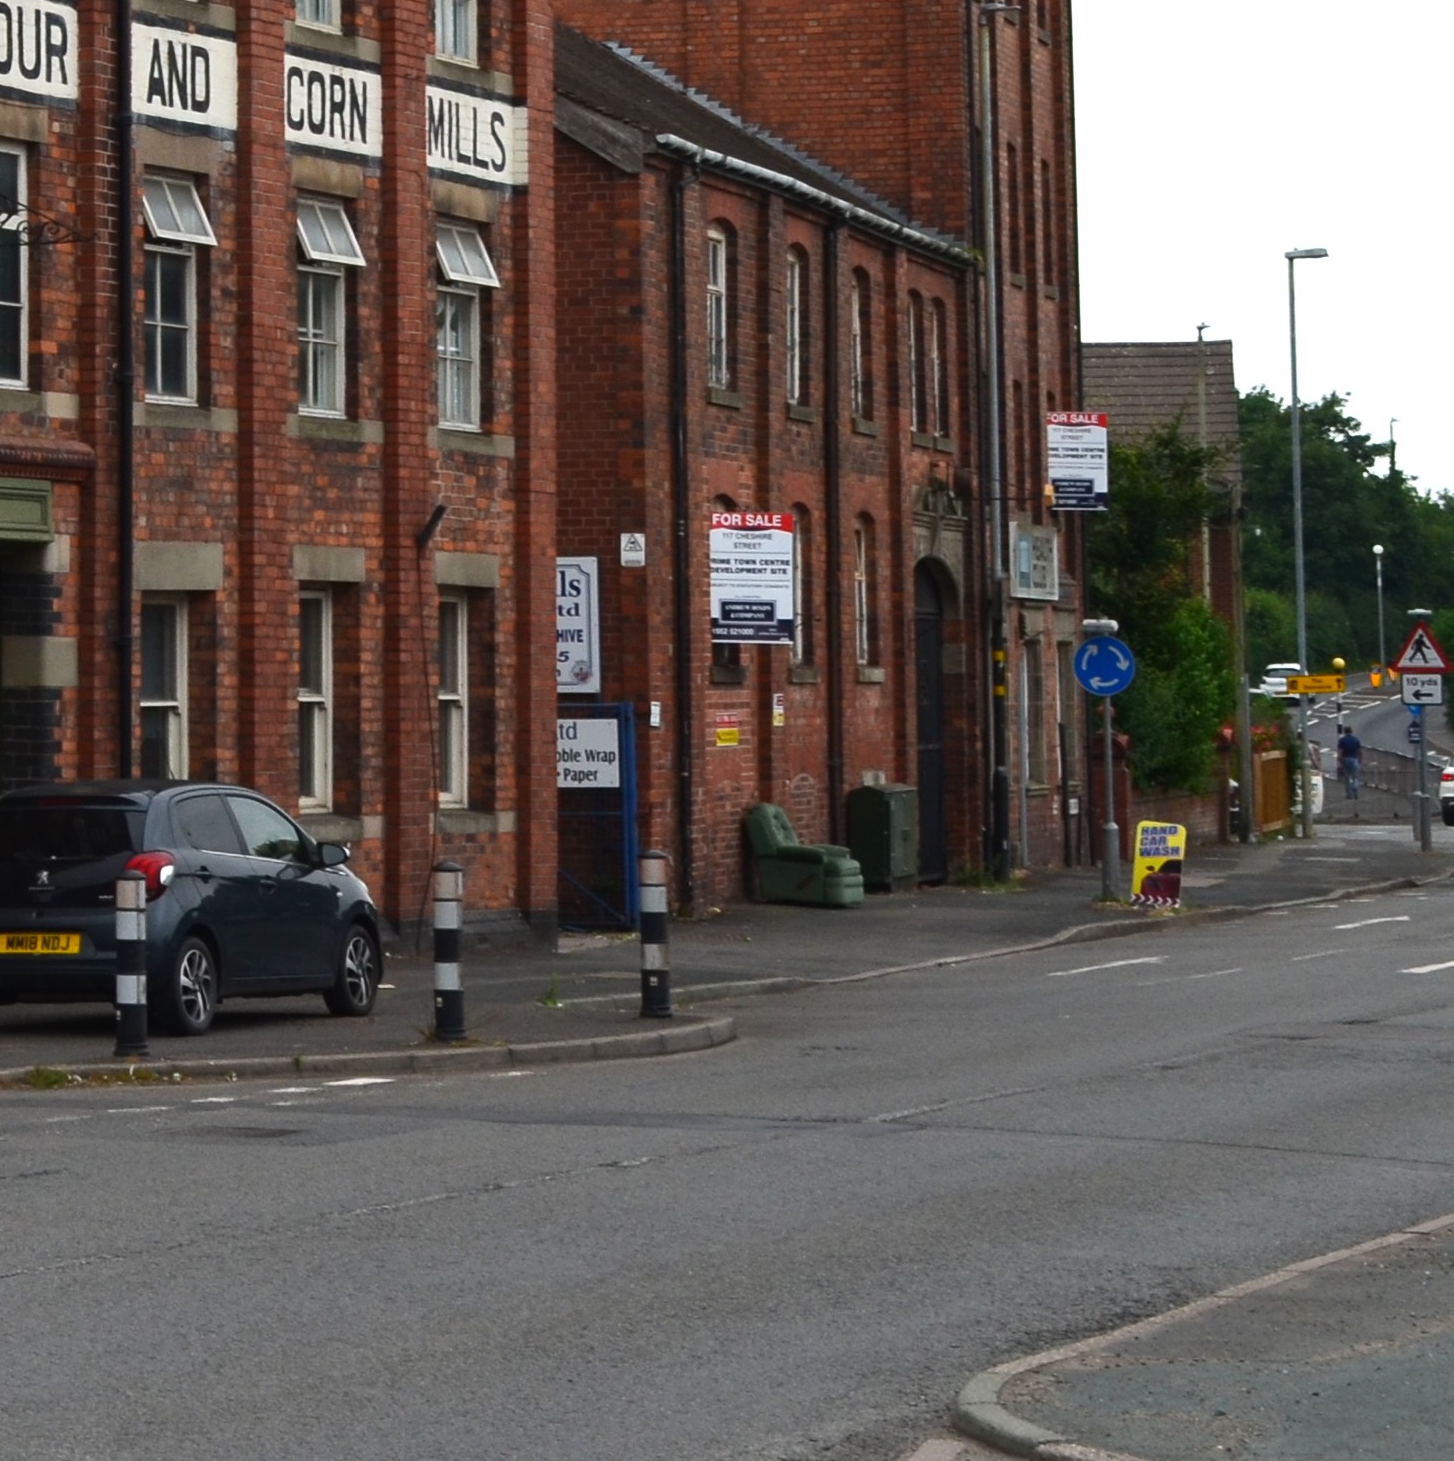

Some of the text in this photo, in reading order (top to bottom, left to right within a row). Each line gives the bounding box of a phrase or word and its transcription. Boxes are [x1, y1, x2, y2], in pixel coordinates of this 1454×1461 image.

[147, 39, 210, 113] AND
[286, 66, 367, 144] CORN
[427, 96, 505, 172] MILLS
[1070, 414, 1098, 423] SALE
[712, 513, 782, 527] FOR SALE
[734, 558, 757, 566] TOWN
[758, 559, 790, 567] CENTRE
[1406, 677, 1438, 688] 10 yds
[584, 749, 616, 765] Wrap
[563, 767, 598, 784] Paper
[1141, 826, 1178, 836] HAND
[1140, 836, 1167, 846] CAR
[1139, 846, 1180, 857] WASH
[5, 935, 71, 951] MM18 NDJ
